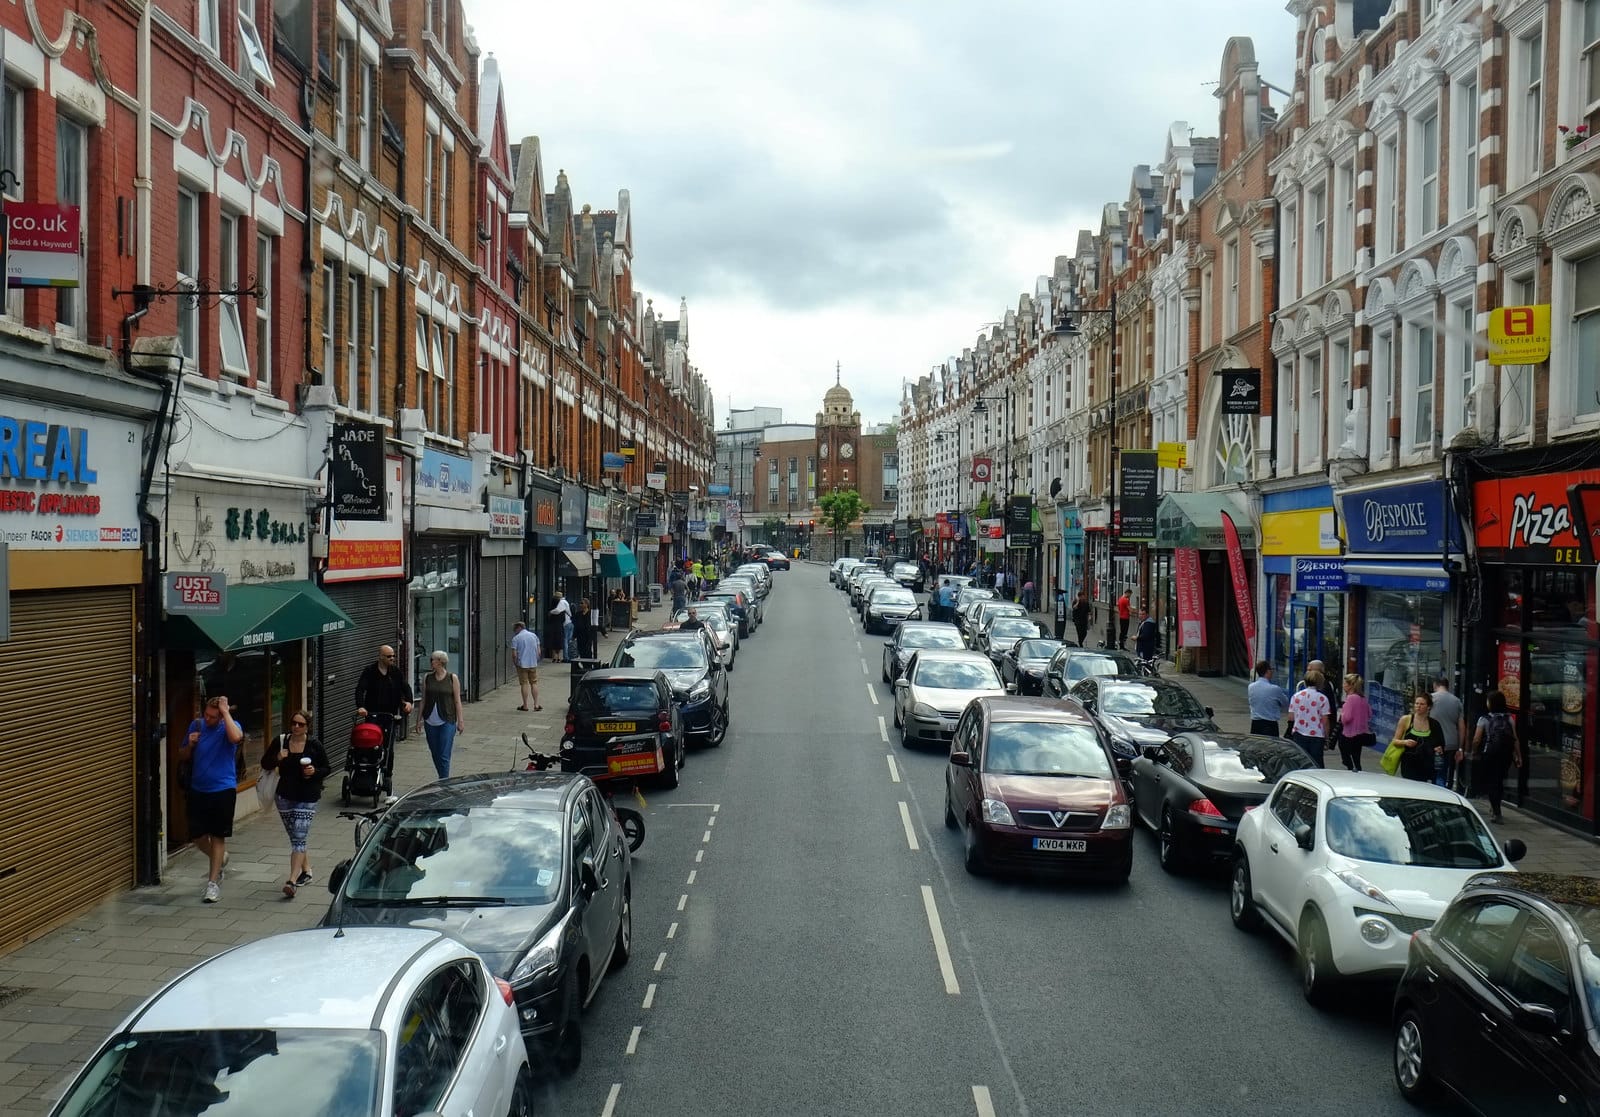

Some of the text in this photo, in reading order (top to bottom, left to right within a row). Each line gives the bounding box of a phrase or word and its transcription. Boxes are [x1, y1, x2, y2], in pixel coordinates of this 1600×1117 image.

[12, 214, 68, 233] co.uk
[41, 240, 72, 249] Hayward
[1492, 336, 1547, 345] litchfields
[127, 431, 136, 443] 21
[340, 430, 375, 443] JADE
[39, 492, 101, 516] APPLIANCES
[341, 493, 373, 504] Chinese
[335, 504, 381, 516] Restaurant
[1363, 499, 1427, 541] BESPOKE
[1509, 493, 1570, 550] Pizza
[31, 529, 52, 541] FAGOR
[66, 528, 98, 542] SIEMENS
[100, 529, 121, 541] Miele
[122, 528, 138, 542] BEKO
[1297, 560, 1345, 572] BESPOK
[175, 577, 211, 590] JUST
[183, 590, 209, 602] EAT
[1039, 840, 1085, 851] KV04 WXR
